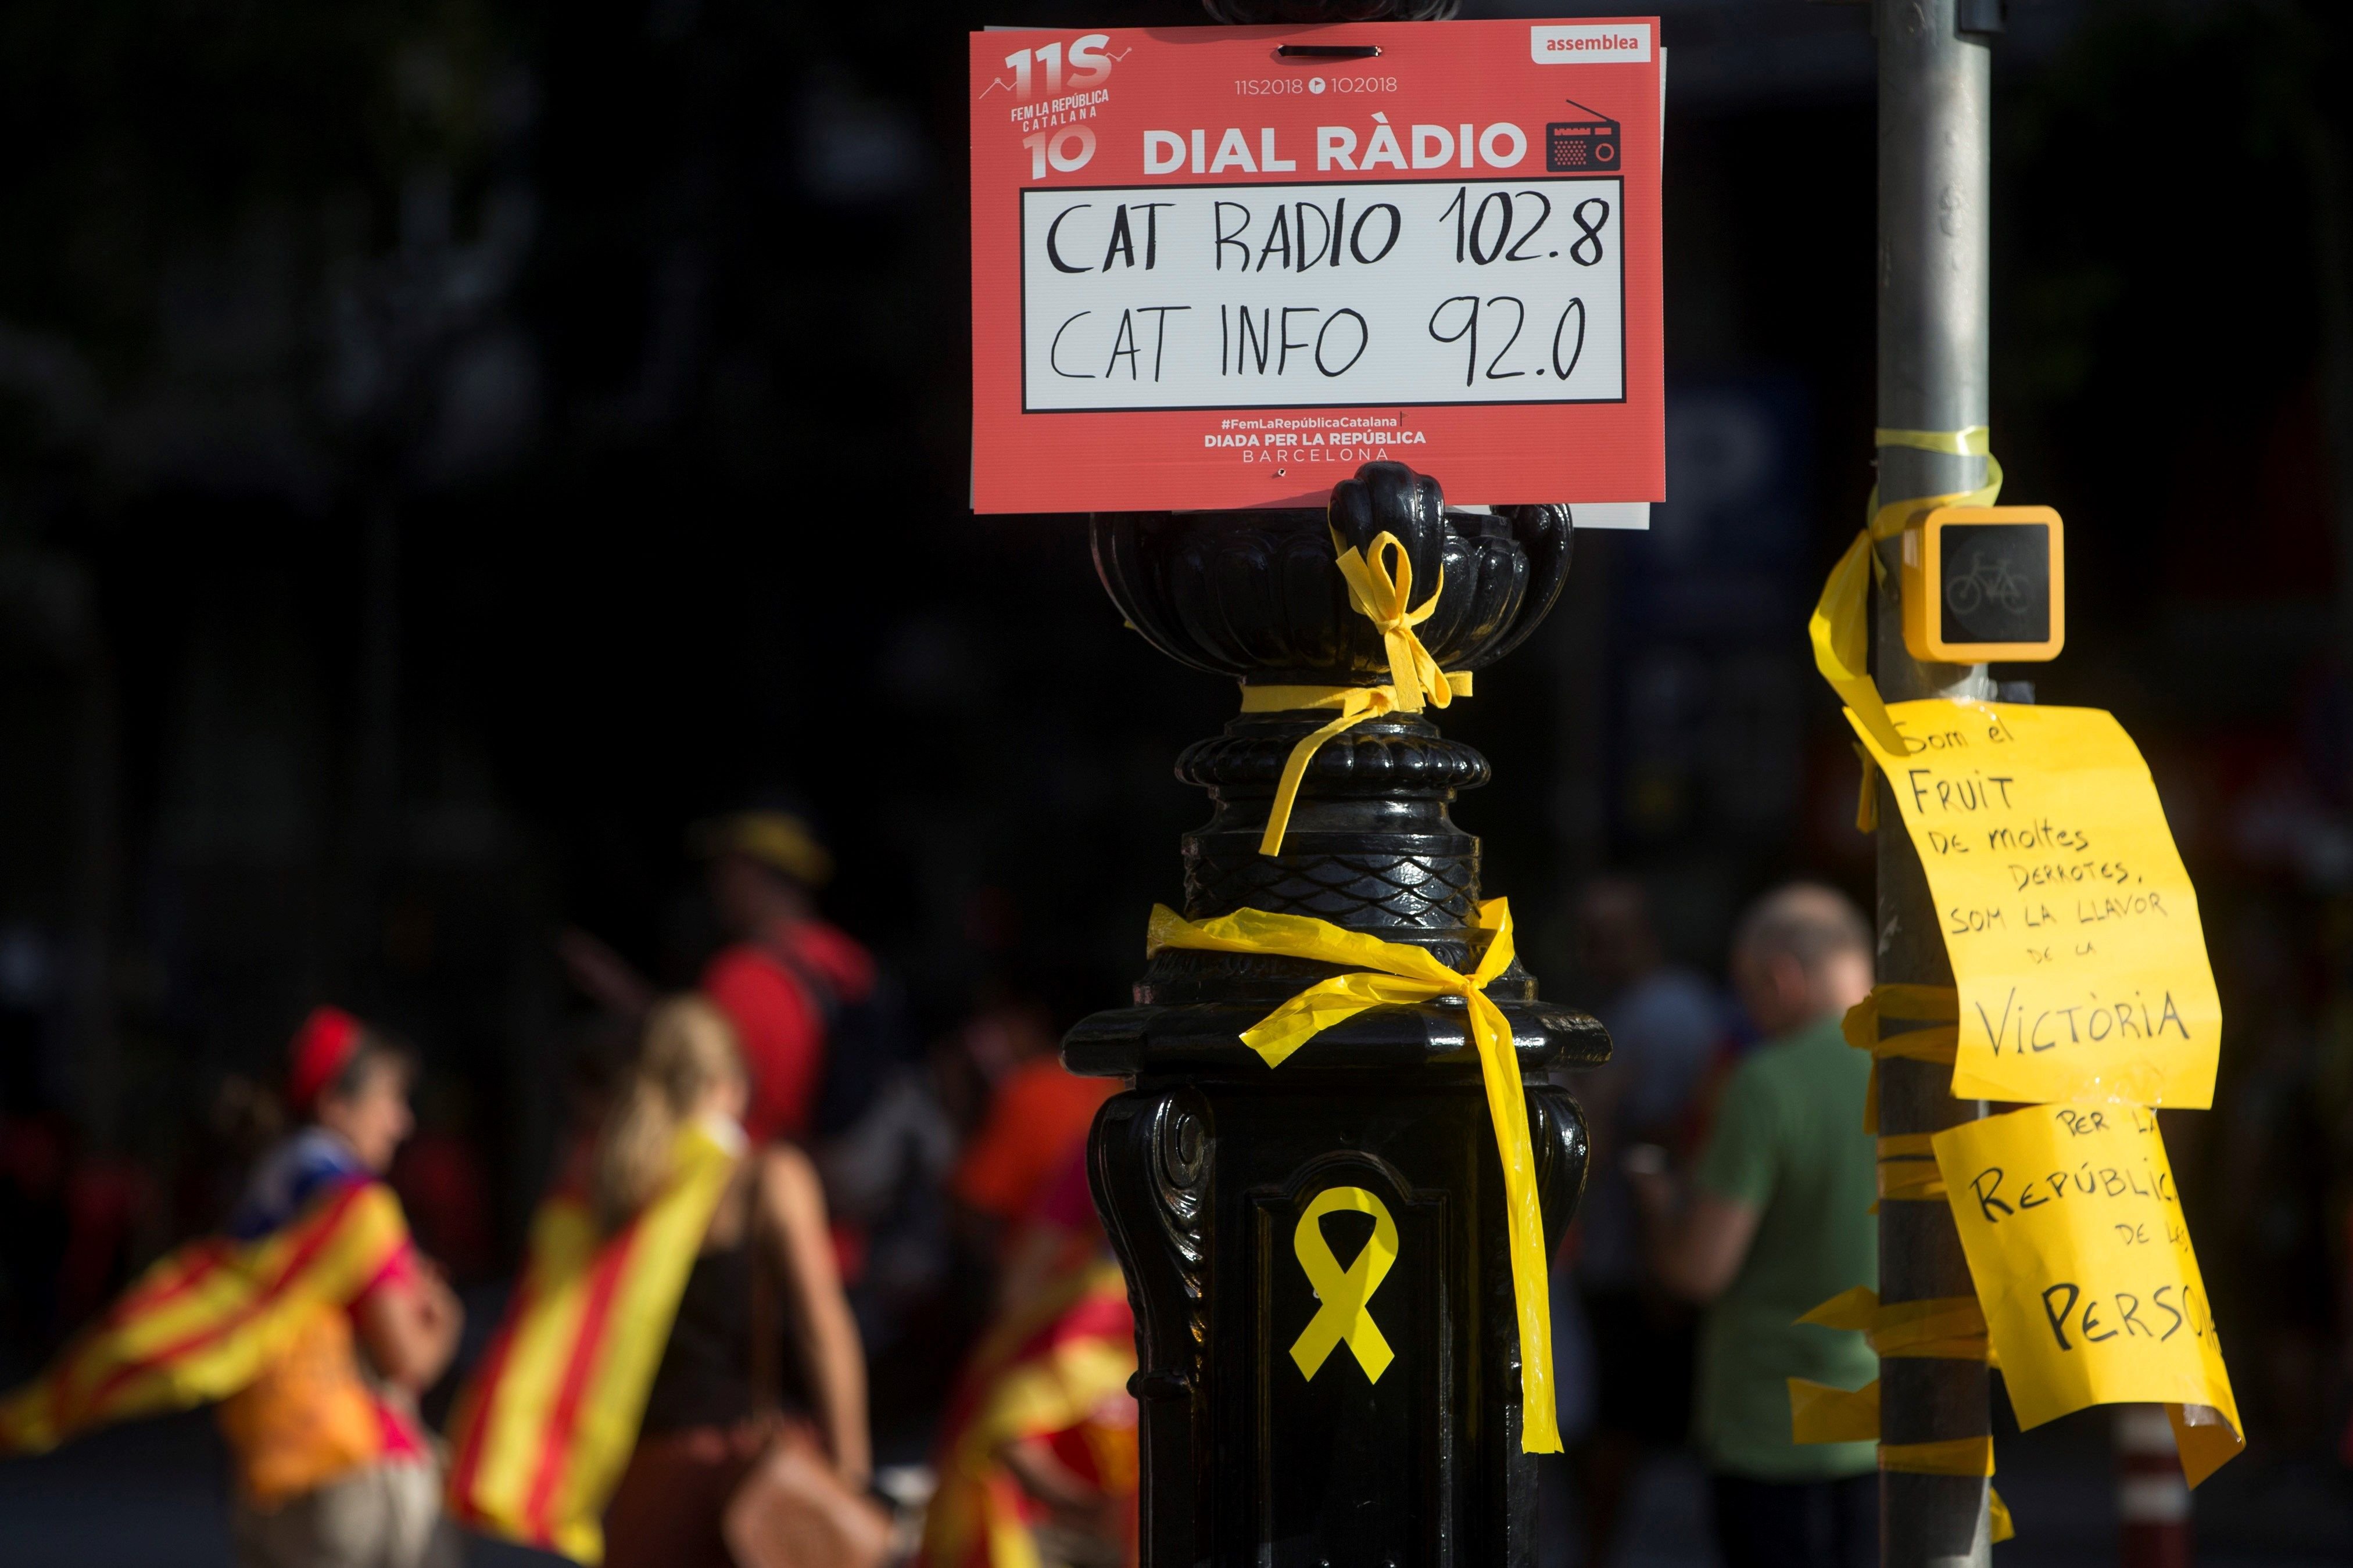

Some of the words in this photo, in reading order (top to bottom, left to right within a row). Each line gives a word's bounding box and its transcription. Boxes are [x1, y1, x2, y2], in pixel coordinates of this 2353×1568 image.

[1546, 34, 1638, 51] assemblea
[1005, 34, 1112, 102] 11S
[1234, 79, 1303, 95] 11S2018
[1011, 105, 1033, 122] FEM
[1036, 102, 1049, 116] LA
[1052, 89, 1109, 113] REPÚBLICA
[1023, 106, 1097, 132] CATALANA
[1144, 128, 1296, 174] DIAL
[1317, 112, 1527, 171] RÀDIO
[1047, 203, 1176, 273] CAT
[1215, 198, 1401, 273] RADIO
[1439, 186, 1610, 266] 102.8
[1051, 306, 1191, 382] CAT
[1222, 304, 1368, 377] INFO
[1429, 296, 1585, 386] 92.0
[1222, 417, 1397, 430] #FemLaRepúblicaCatalana
[1205, 435, 1260, 447] DIADA
[1265, 434, 1298, 446] PER
[1302, 433, 1325, 446] LA
[1330, 429, 1426, 445] REPÚBLICA
[1243, 448, 1388, 462] BARCELONA
[1989, 715, 2014, 744] el
[1928, 831, 1969, 854] DE
[1989, 817, 2089, 852] moltes
[1951, 907, 2006, 934] SOM
[2025, 903, 2057, 927] LA
[2078, 892, 2168, 924] LLAVOR
[2027, 947, 2053, 964] DE
[2075, 940, 2096, 956] LA
[2055, 1110, 2111, 1137] PER
[2114, 1223, 2149, 1245] DE
